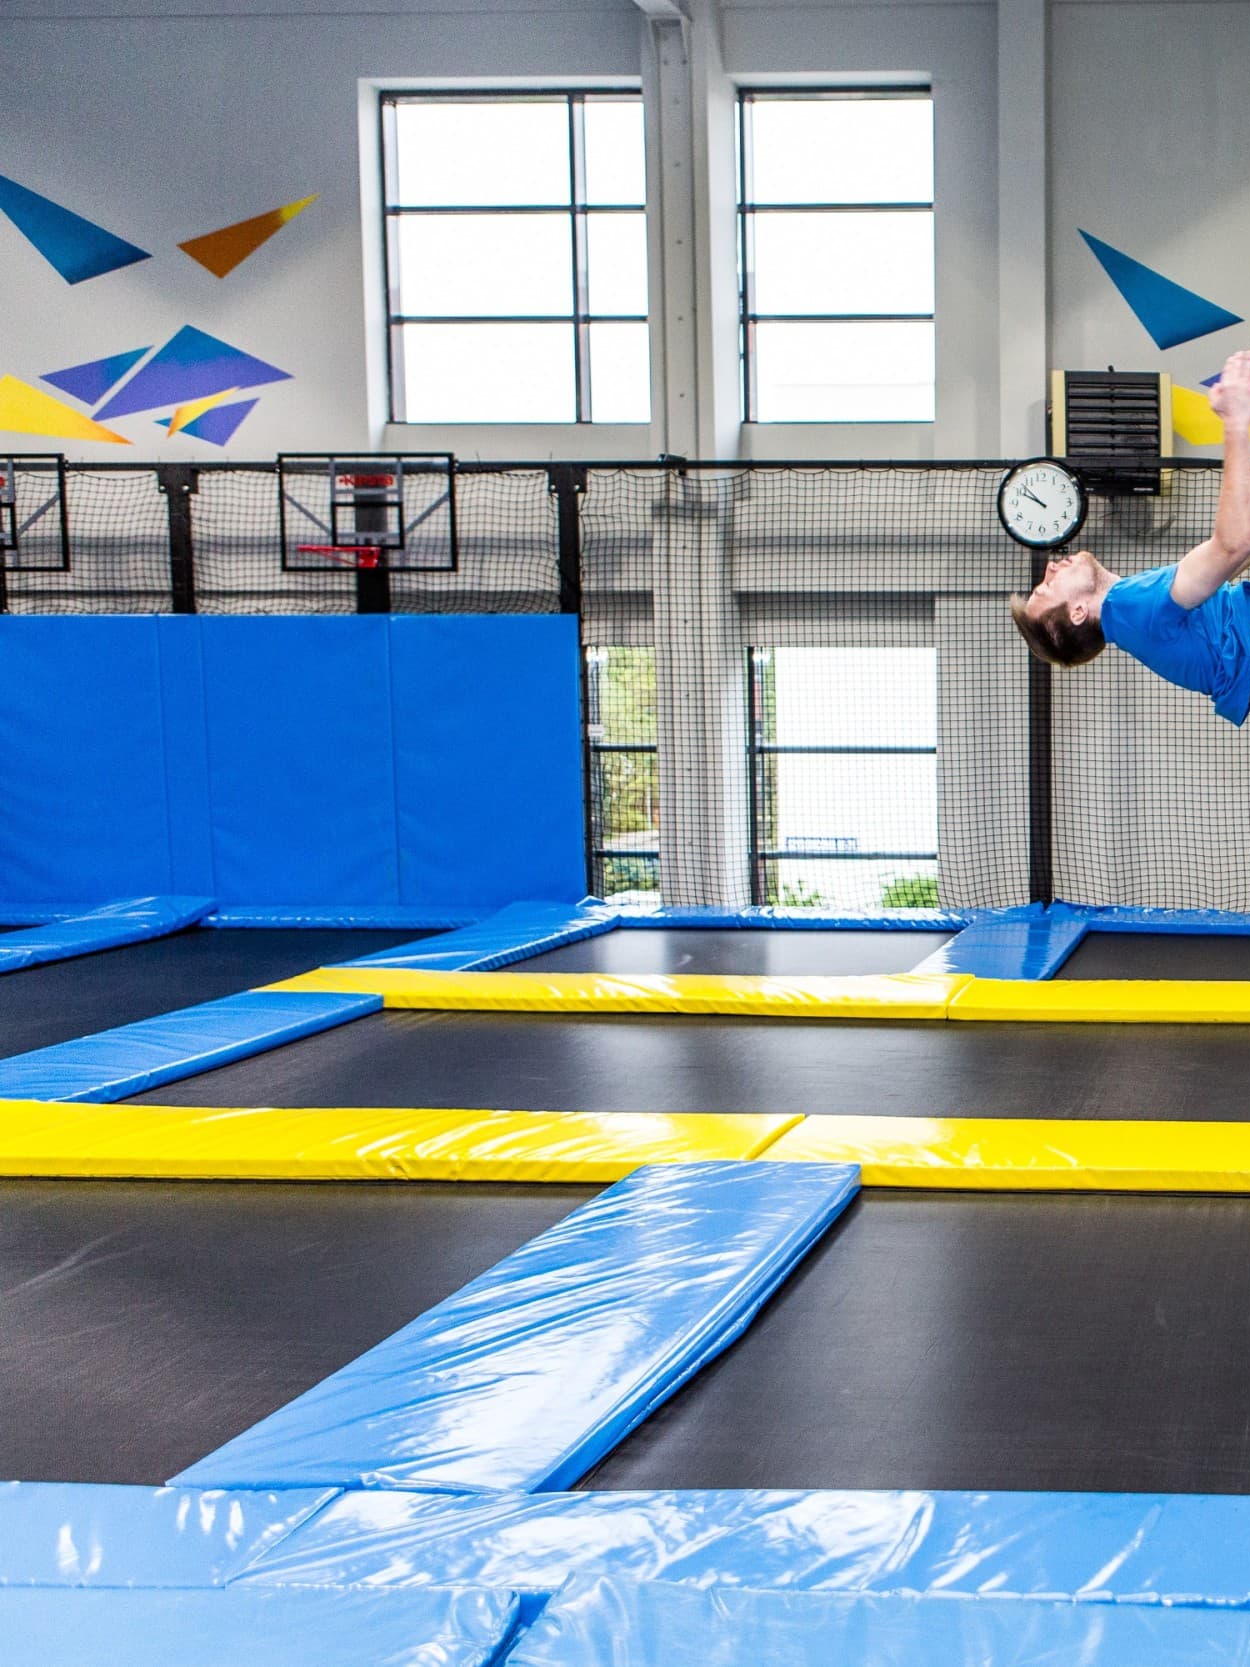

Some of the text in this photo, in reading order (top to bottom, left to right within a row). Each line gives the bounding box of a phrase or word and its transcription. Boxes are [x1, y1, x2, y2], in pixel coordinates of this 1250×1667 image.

[1025, 477, 1033, 486] 11
[1036, 472, 1047, 482] 12
[1060, 484, 1066, 493] 2
[1011, 498, 1019, 507] 9
[1066, 497, 1073, 507] 3
[1015, 512, 1023, 521] 8
[1060, 511, 1067, 520] 4
[1027, 521, 1033, 531] 7
[1038, 524, 1046, 533] 6
[1053, 520, 1060, 531] 5
